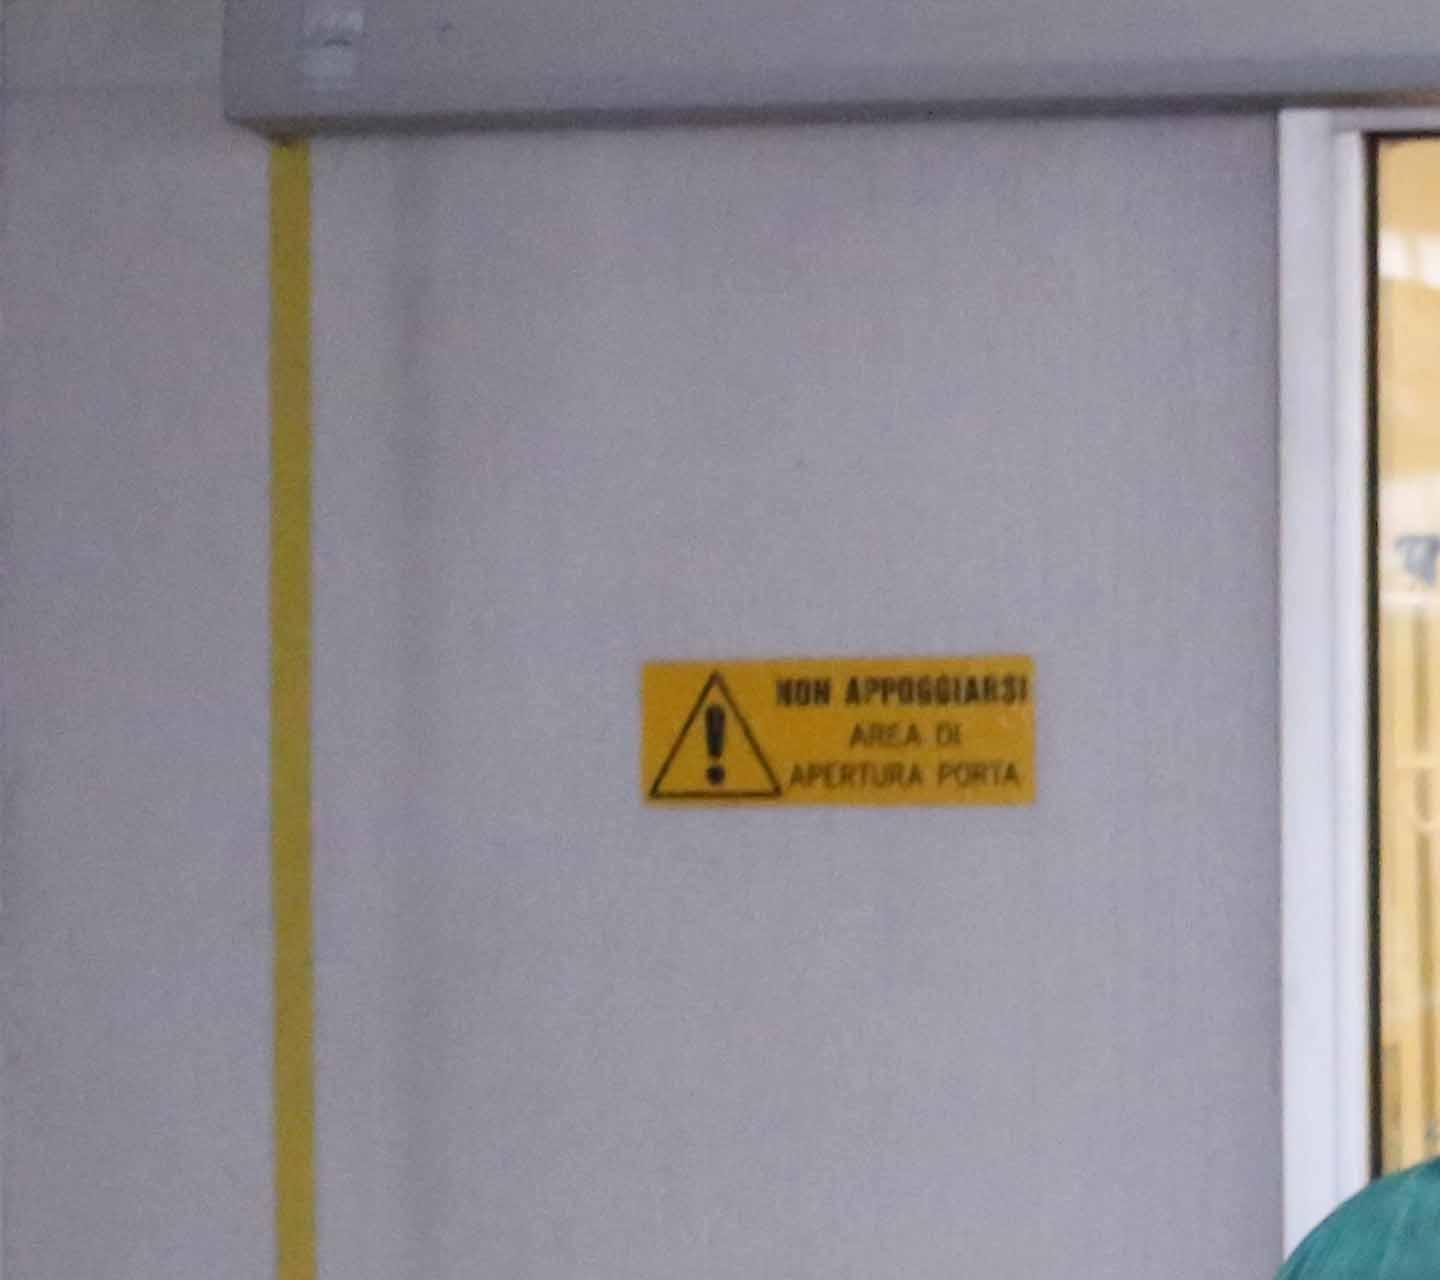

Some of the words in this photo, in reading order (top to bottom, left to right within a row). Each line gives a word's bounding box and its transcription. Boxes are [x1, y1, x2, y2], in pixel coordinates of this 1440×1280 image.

[776, 677, 831, 707] NON
[845, 674, 1028, 706] APPOGGIARSI
[849, 722, 923, 749] AREA
[935, 722, 961, 747] DI
[789, 761, 924, 788] APERTURA
[937, 760, 1020, 786] PORTA
